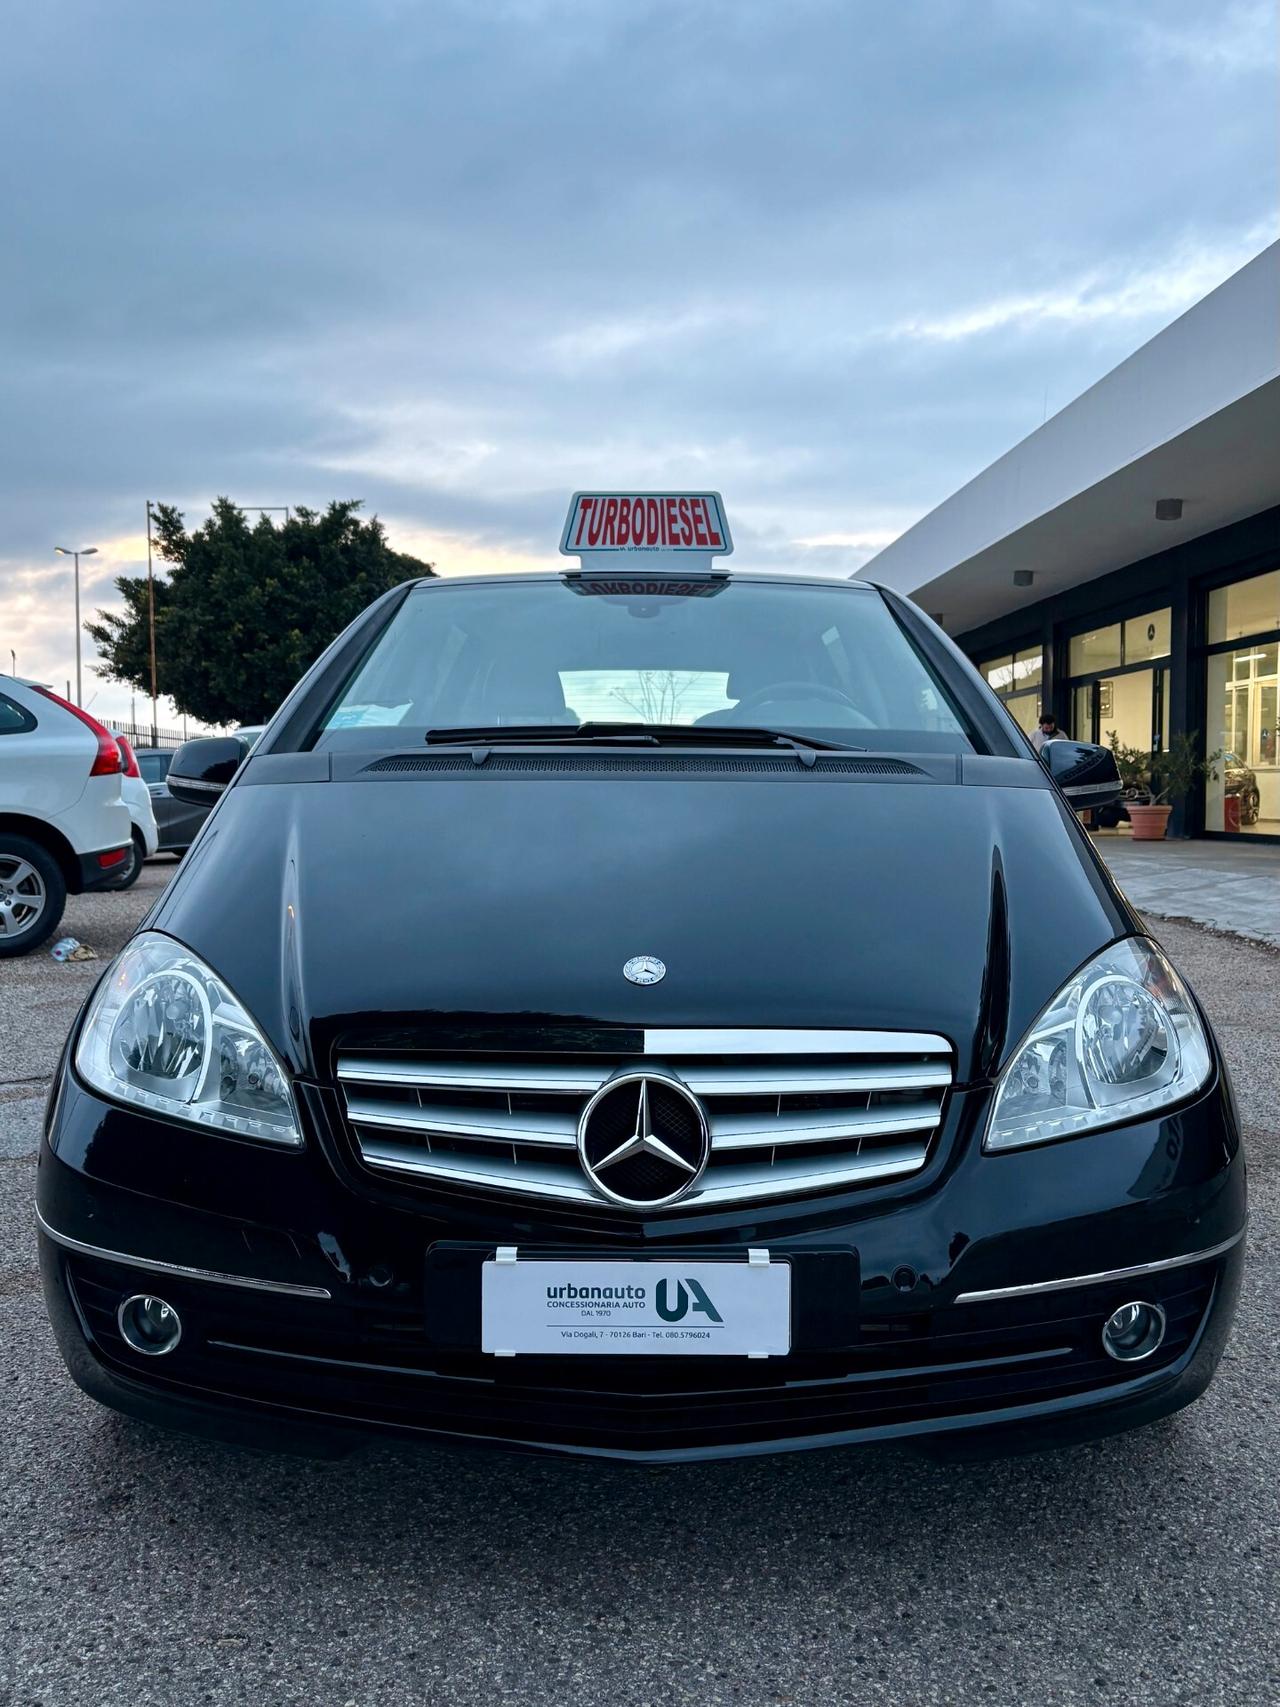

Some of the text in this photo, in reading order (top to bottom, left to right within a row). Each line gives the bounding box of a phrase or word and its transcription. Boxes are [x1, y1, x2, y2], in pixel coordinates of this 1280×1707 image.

[575, 498, 722, 546] TURBODIESEL
[546, 1283, 646, 1299] urbanauto
[546, 1300, 646, 1309] CONCESSIONARIA AUTO
[655, 1278, 724, 1323] UA
